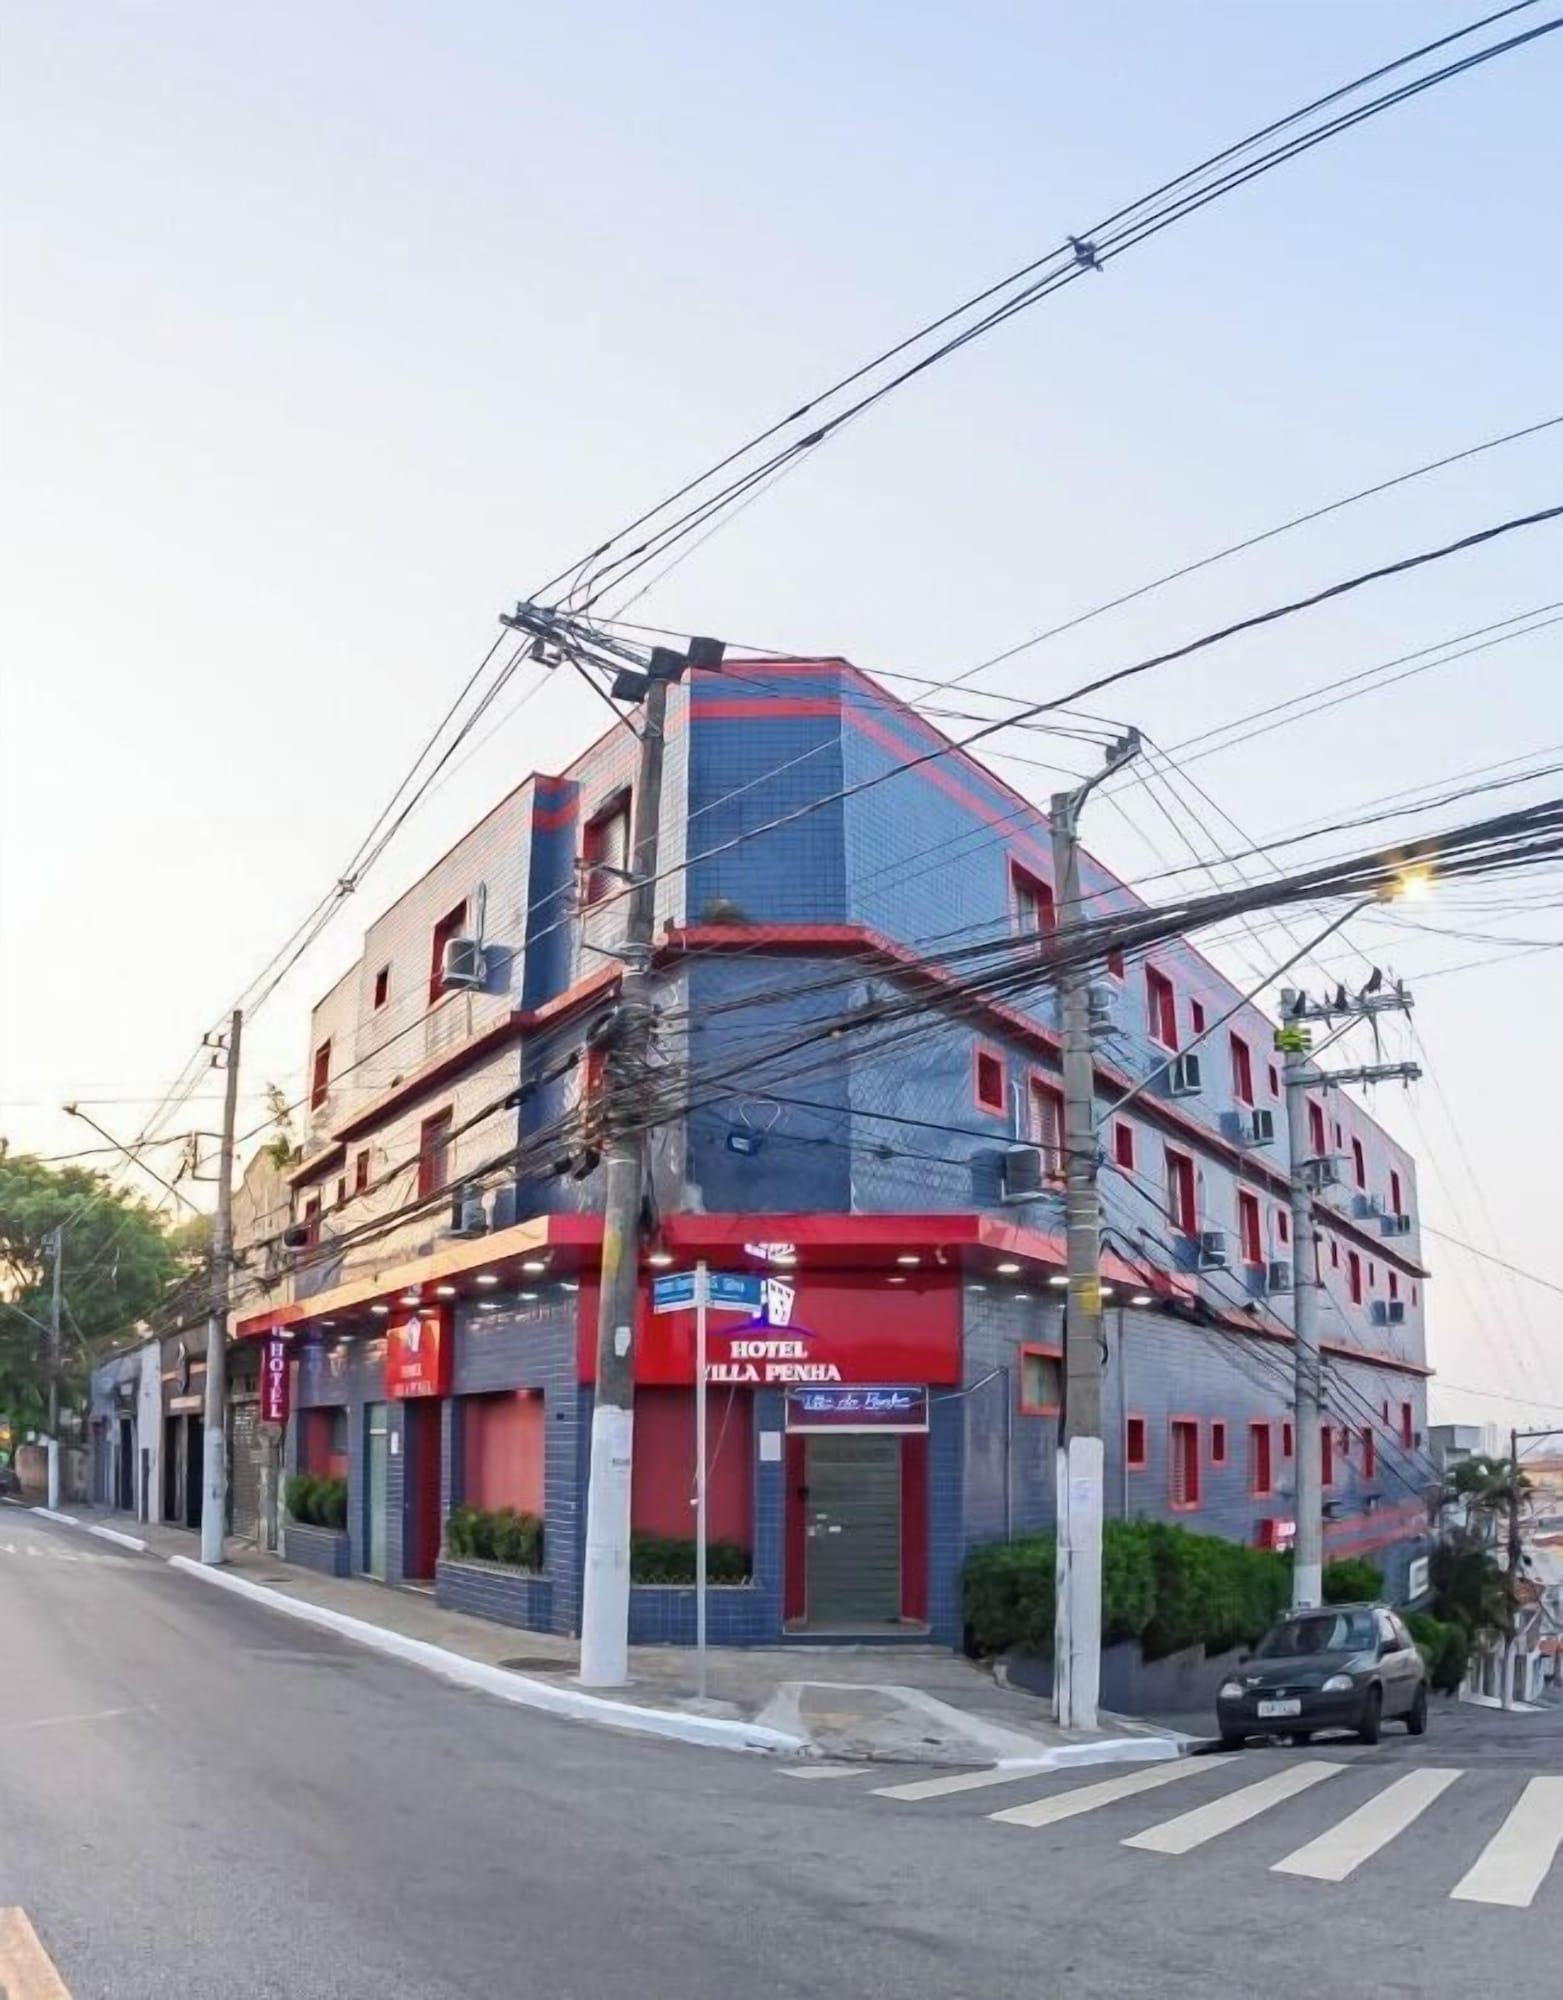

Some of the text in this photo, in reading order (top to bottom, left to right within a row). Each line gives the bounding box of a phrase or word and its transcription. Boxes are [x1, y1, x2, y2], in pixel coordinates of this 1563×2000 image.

[730, 1341, 808, 1359] HOTEL
[269, 1343, 283, 1417] HOTEL
[766, 1364, 842, 1382] PENHA
